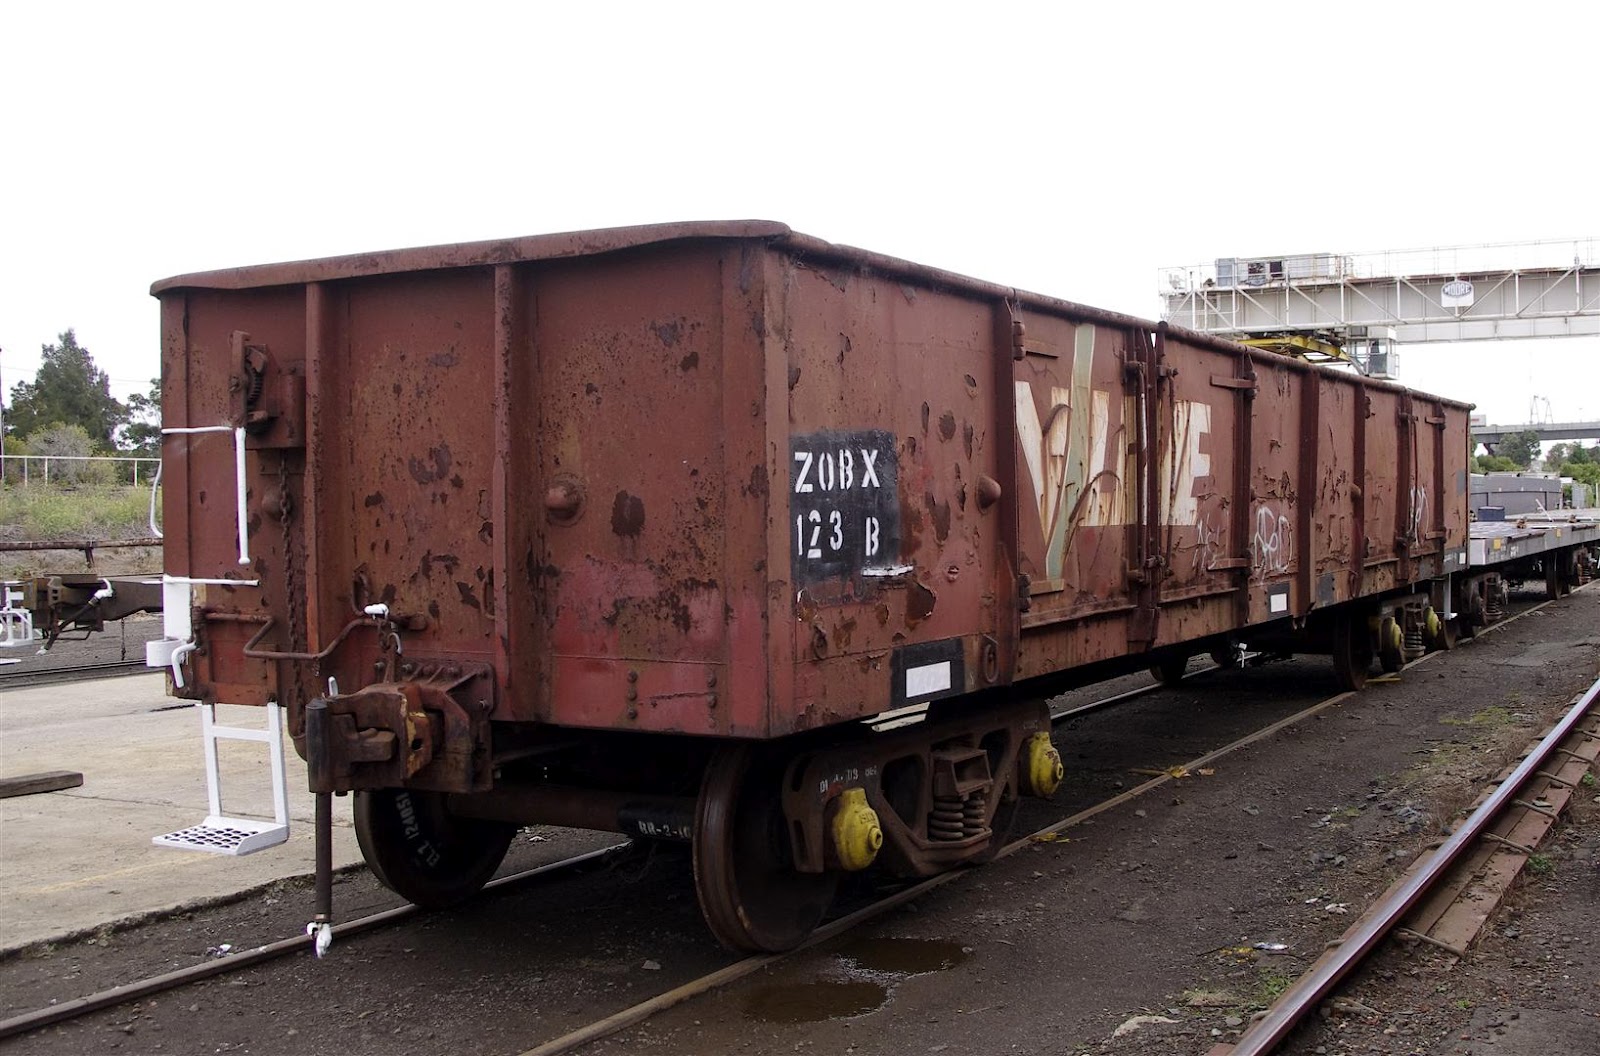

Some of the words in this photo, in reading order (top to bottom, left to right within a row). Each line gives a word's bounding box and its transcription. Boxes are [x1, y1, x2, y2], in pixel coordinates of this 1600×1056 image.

[794, 449, 881, 493] ZOBX
[796, 509, 843, 559] 123
[865, 516, 880, 557] B
